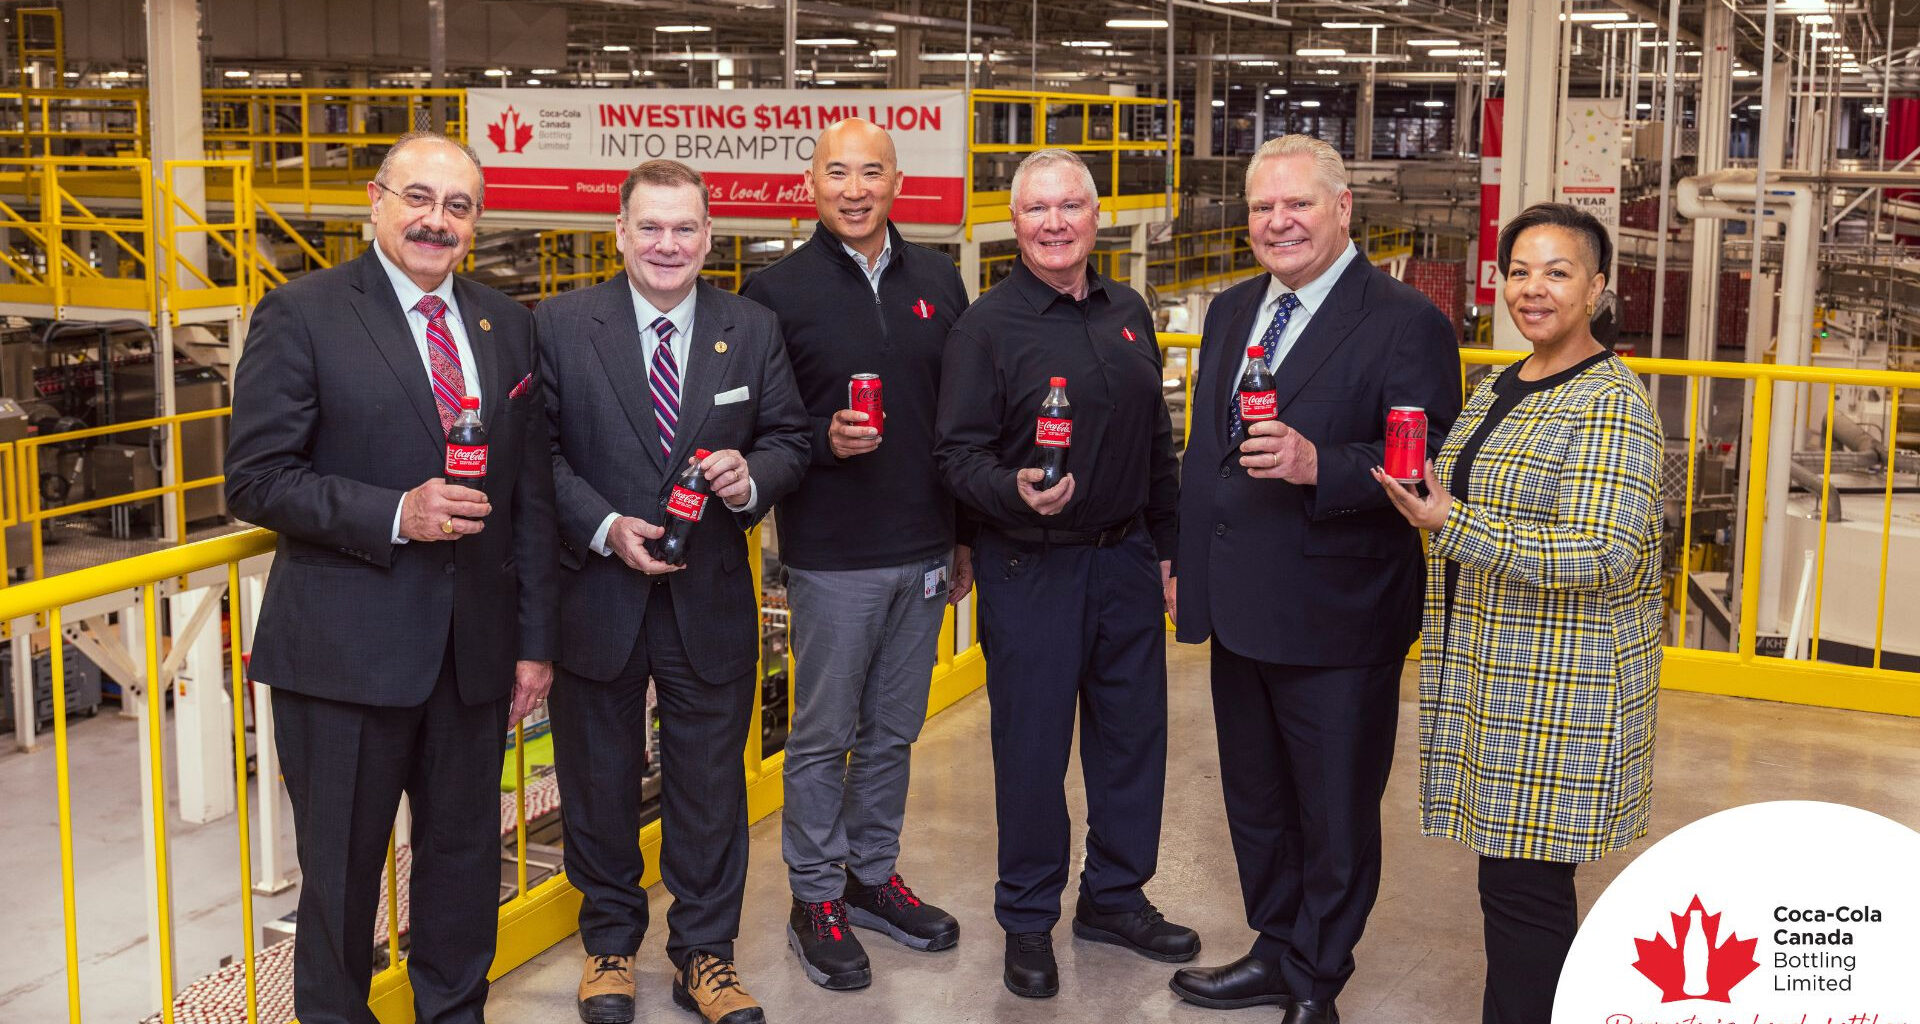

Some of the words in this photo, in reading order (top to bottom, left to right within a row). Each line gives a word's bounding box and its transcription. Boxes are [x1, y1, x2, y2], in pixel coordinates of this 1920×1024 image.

[539, 109, 581, 118] Coca-Cola
[600, 104, 746, 129] INVESTING
[754, 104, 812, 131] $141
[539, 120, 571, 129] Canada
[538, 131, 572, 141] Bottling
[538, 142, 569, 151] Limited
[601, 133, 665, 158] INTO
[675, 135, 817, 161] BRAMPTO
[576, 182, 605, 193] Proud
[606, 184, 617, 193] to
[729, 180, 770, 201] local
[1576, 197, 1606, 206] YEAR
